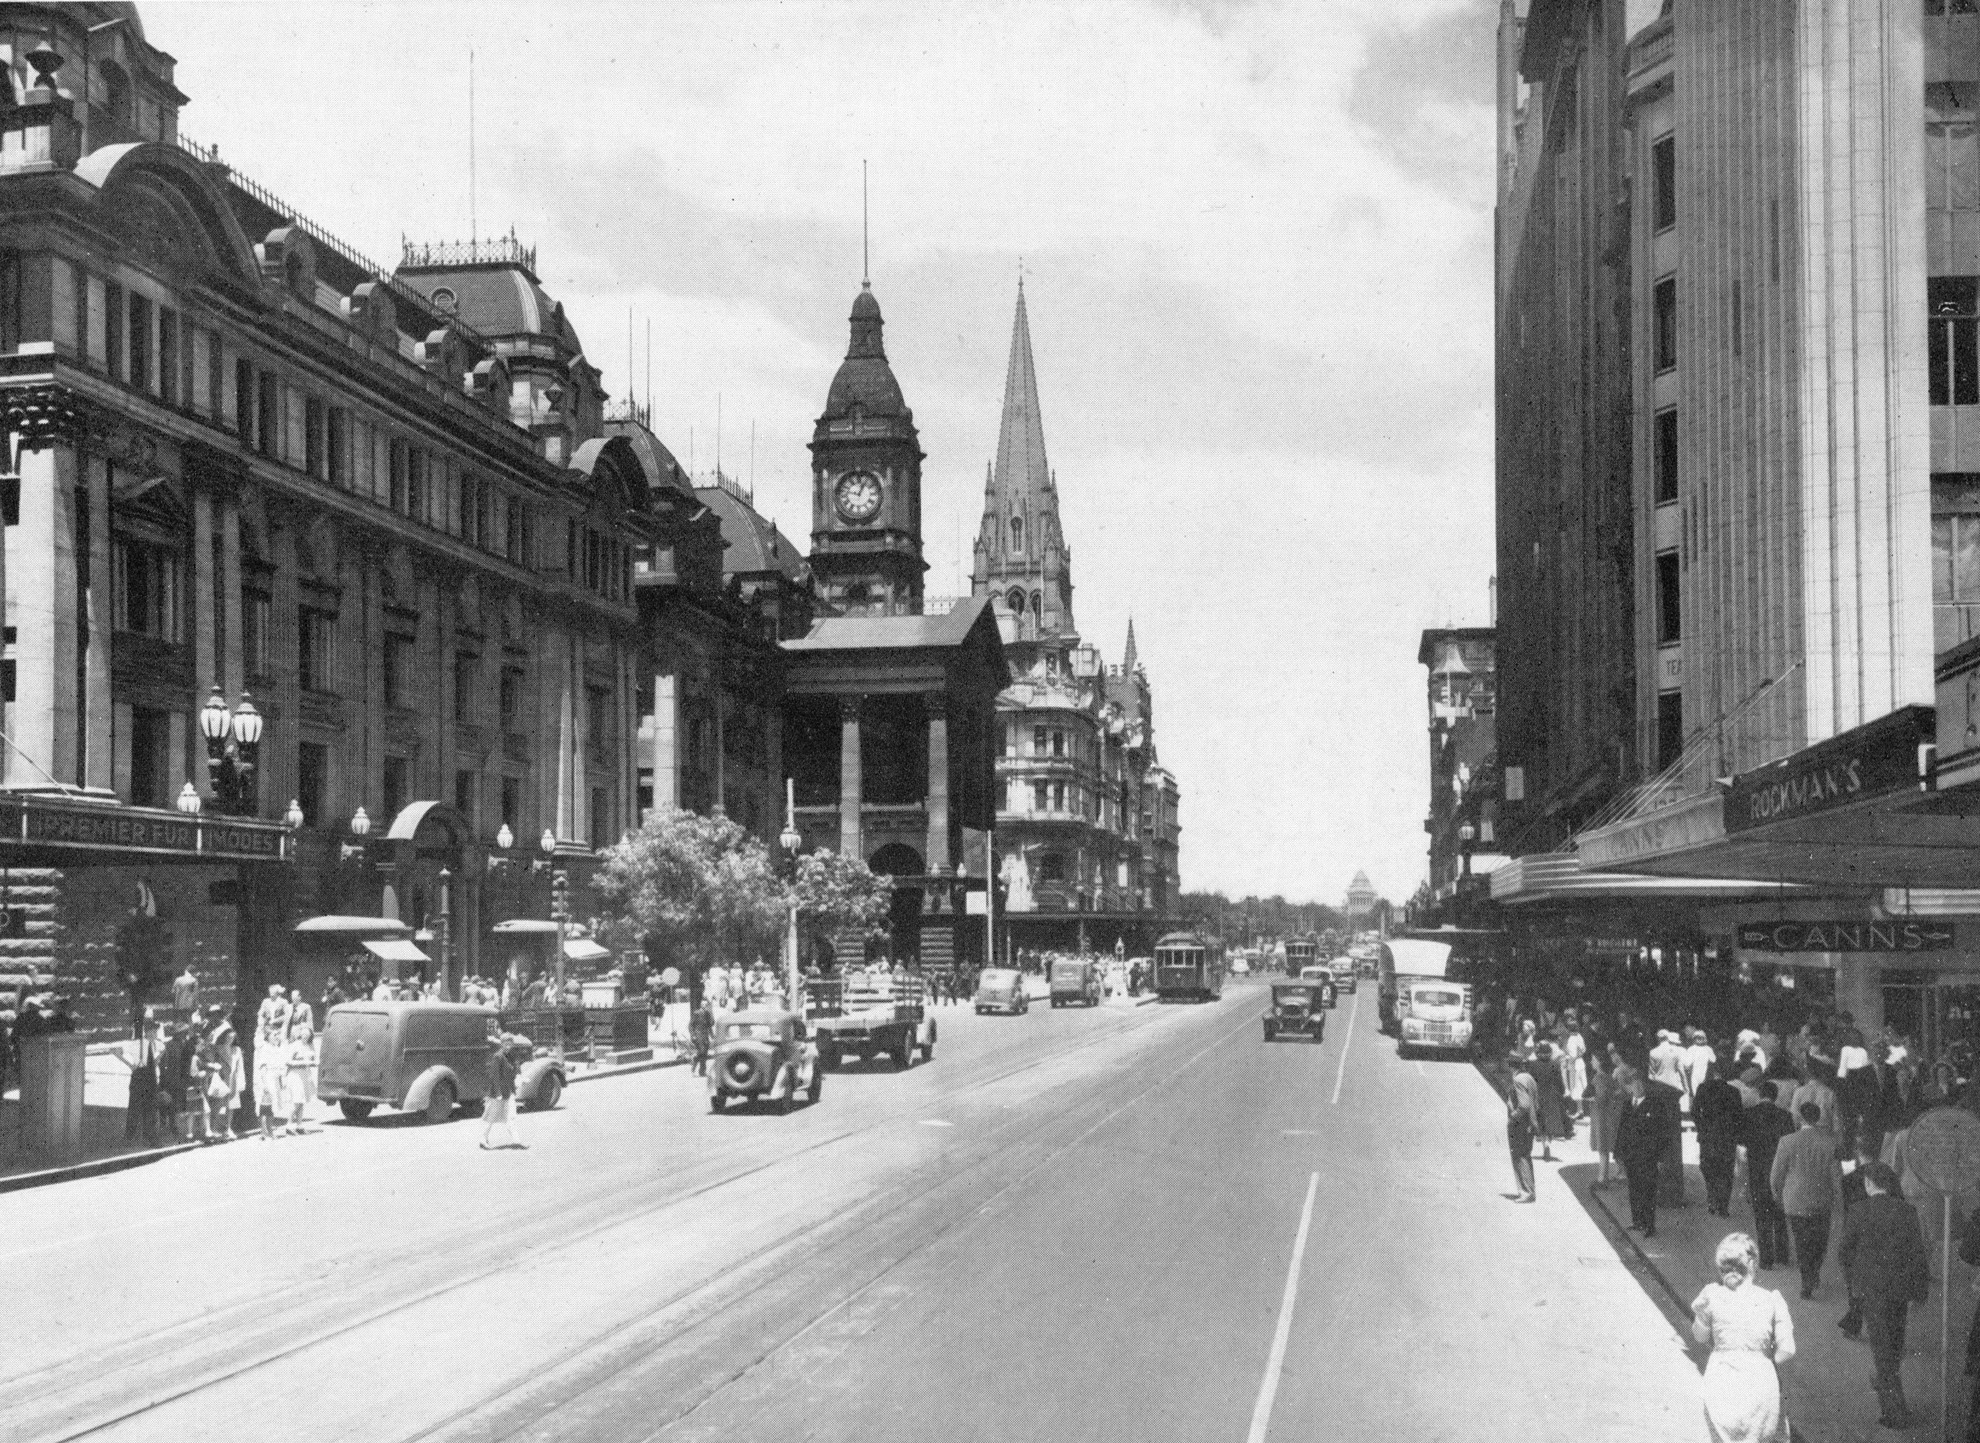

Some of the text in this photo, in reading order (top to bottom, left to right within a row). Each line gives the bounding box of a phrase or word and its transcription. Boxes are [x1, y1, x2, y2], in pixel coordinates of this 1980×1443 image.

[152, 823, 190, 846] FUR
[208, 831, 273, 853] MODES
[1773, 924, 1922, 948] CANNS
